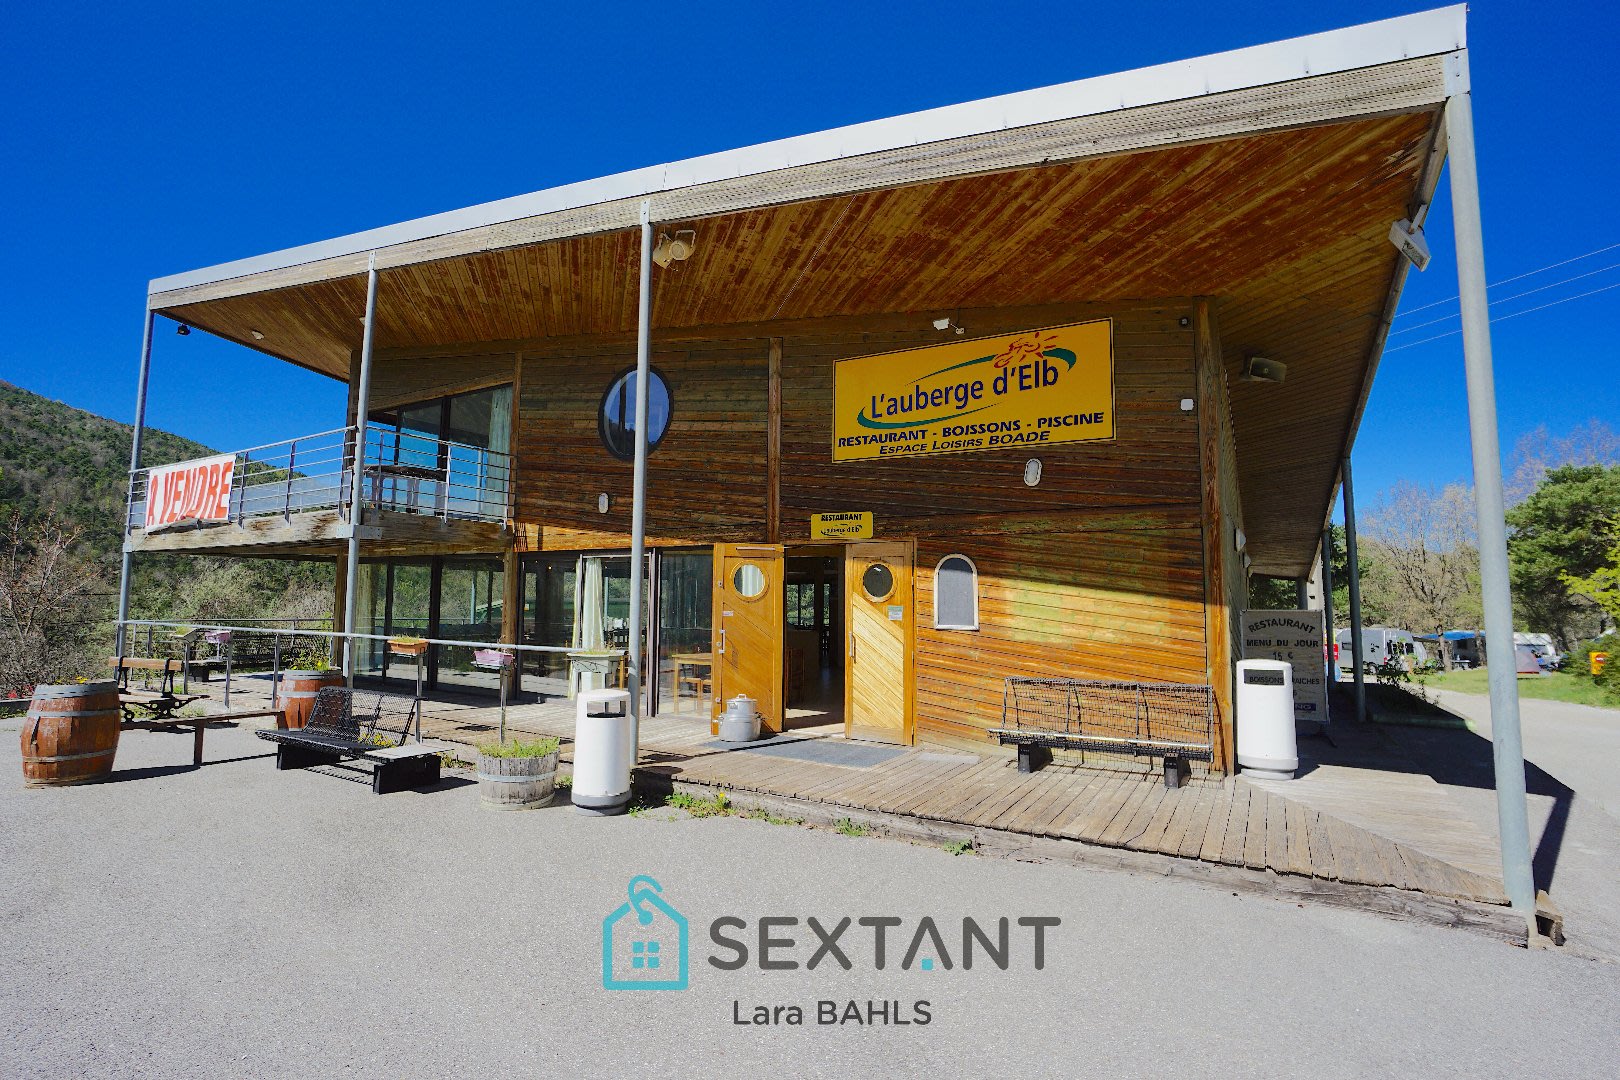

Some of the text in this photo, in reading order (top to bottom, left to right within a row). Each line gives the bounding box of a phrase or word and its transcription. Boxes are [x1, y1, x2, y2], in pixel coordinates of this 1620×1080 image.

[871, 359, 1059, 419] L'auberge d'Elb
[838, 430, 928, 448] RESTAURANT
[942, 420, 1021, 438] BOISSONS
[1037, 412, 1104, 429] PISCINE
[932, 437, 983, 451] LOISIRS
[988, 430, 1050, 445] BOADE
[147, 462, 233, 526] A VENDRE
[1248, 618, 1316, 634] RESTAURANT
[1246, 639, 1319, 647] MENU DU JOUR
